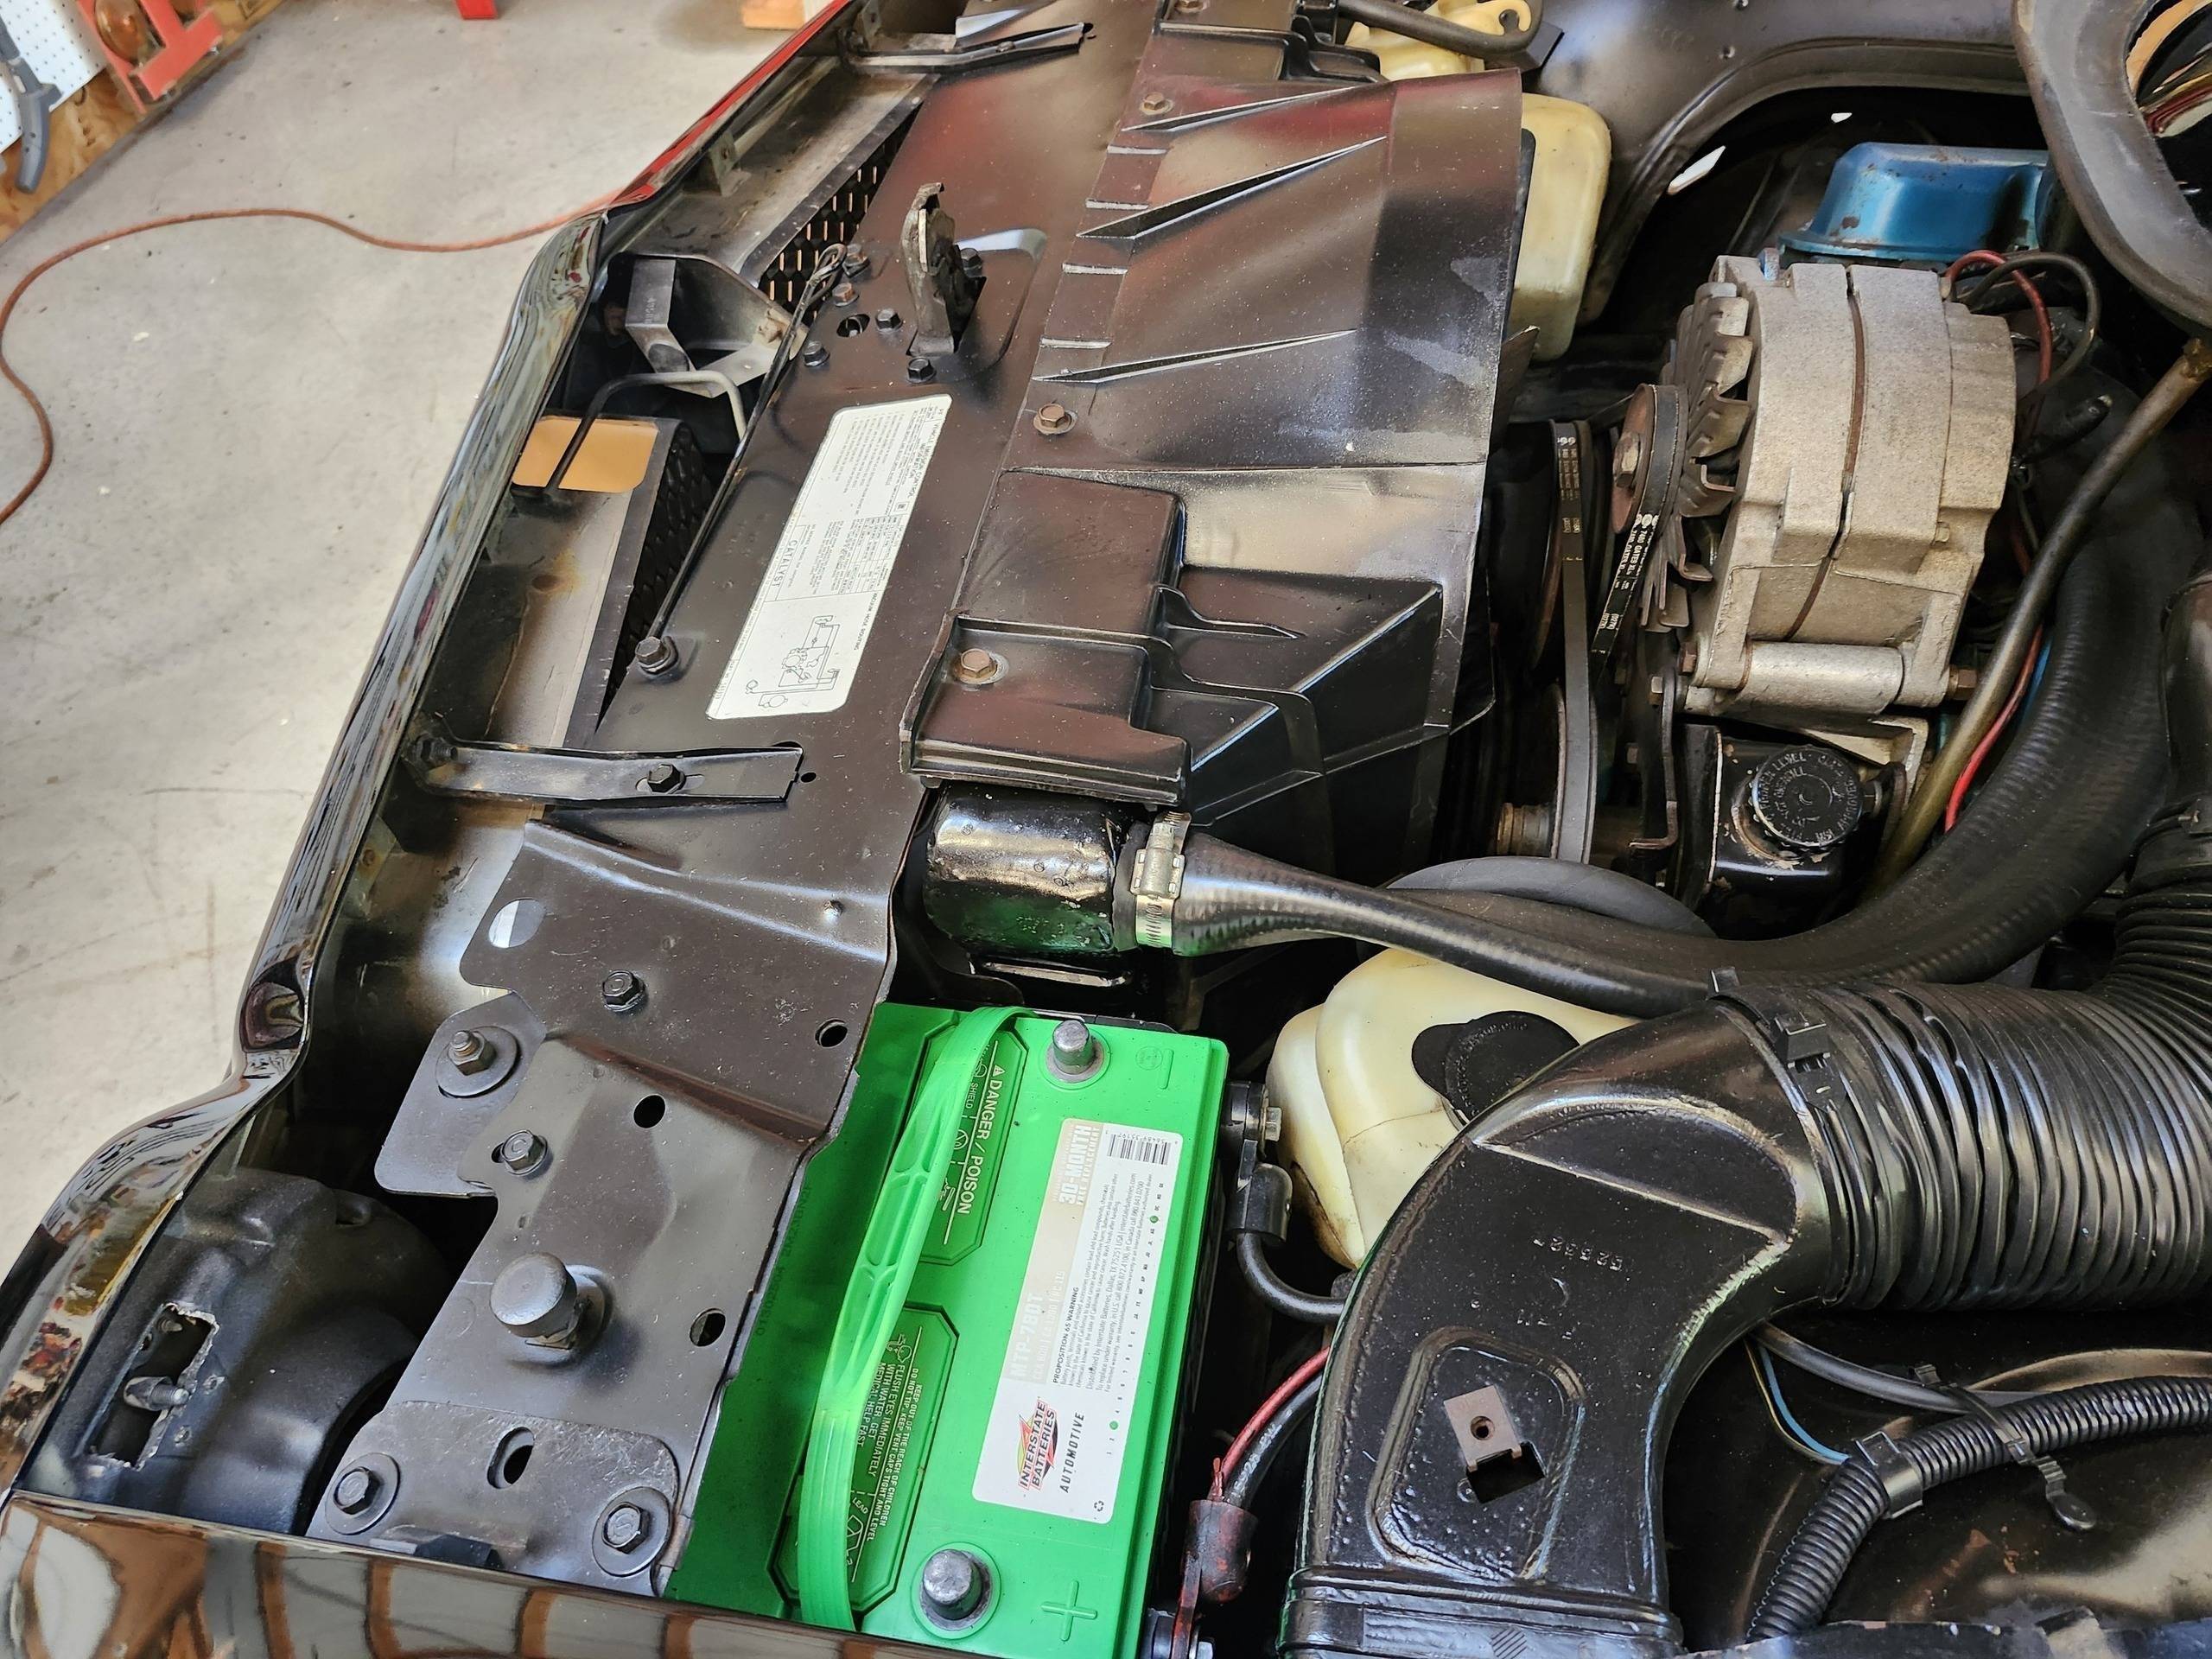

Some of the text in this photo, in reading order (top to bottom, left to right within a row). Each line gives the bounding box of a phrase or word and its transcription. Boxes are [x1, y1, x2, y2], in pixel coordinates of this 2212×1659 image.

[906, 472, 922, 498] CONTROL
[771, 539, 798, 588] CATALYST
[1630, 543, 1643, 564] GATES
[853, 628, 865, 650] ROUTING
[964, 1083, 978, 1109] SHIELD
[976, 1079, 1002, 1139] DANGER
[1058, 1124, 1091, 1205] 30-MONTH
[1076, 1127, 1100, 1205] FREE REPLACEMENT
[956, 1155, 983, 1214] POISON
[1116, 1233, 1124, 1245] USA
[1109, 1264, 1118, 1273] TX
[1111, 1247, 1122, 1265] 75251
[1102, 1344, 1111, 1362] under
[1125, 1225, 1135, 1245] Canada
[1052, 1286, 1079, 1383] PROPOSITION 65 WARNING
[1094, 1319, 1106, 1347] Interstate
[880, 1363, 895, 1386] WITH
[905, 1379, 915, 1395] NOT
[856, 1362, 887, 1446] MEDICAL HELP FAST
[866, 1422, 879, 1439] GET
[867, 1364, 905, 1477] FLUSH EYES IMMEDIATELY
[895, 1412, 906, 1432] KEEP
[878, 1383, 922, 1526] KEEP OUT OF THE REACH OF CHILDREN
[890, 1433, 901, 1452] VENT
[1019, 1402, 1046, 1487] INTERSTATE
[1031, 1409, 1055, 1486] BATTERIES
[1058, 1411, 1084, 1492] AUTOMOTIVE
[884, 1453, 896, 1473] CAPS
[878, 1475, 890, 1497] TIGHT
[852, 1497, 869, 1515] LEAD
[873, 1498, 884, 1515] AND
[866, 1517, 879, 1541] LEVEL
